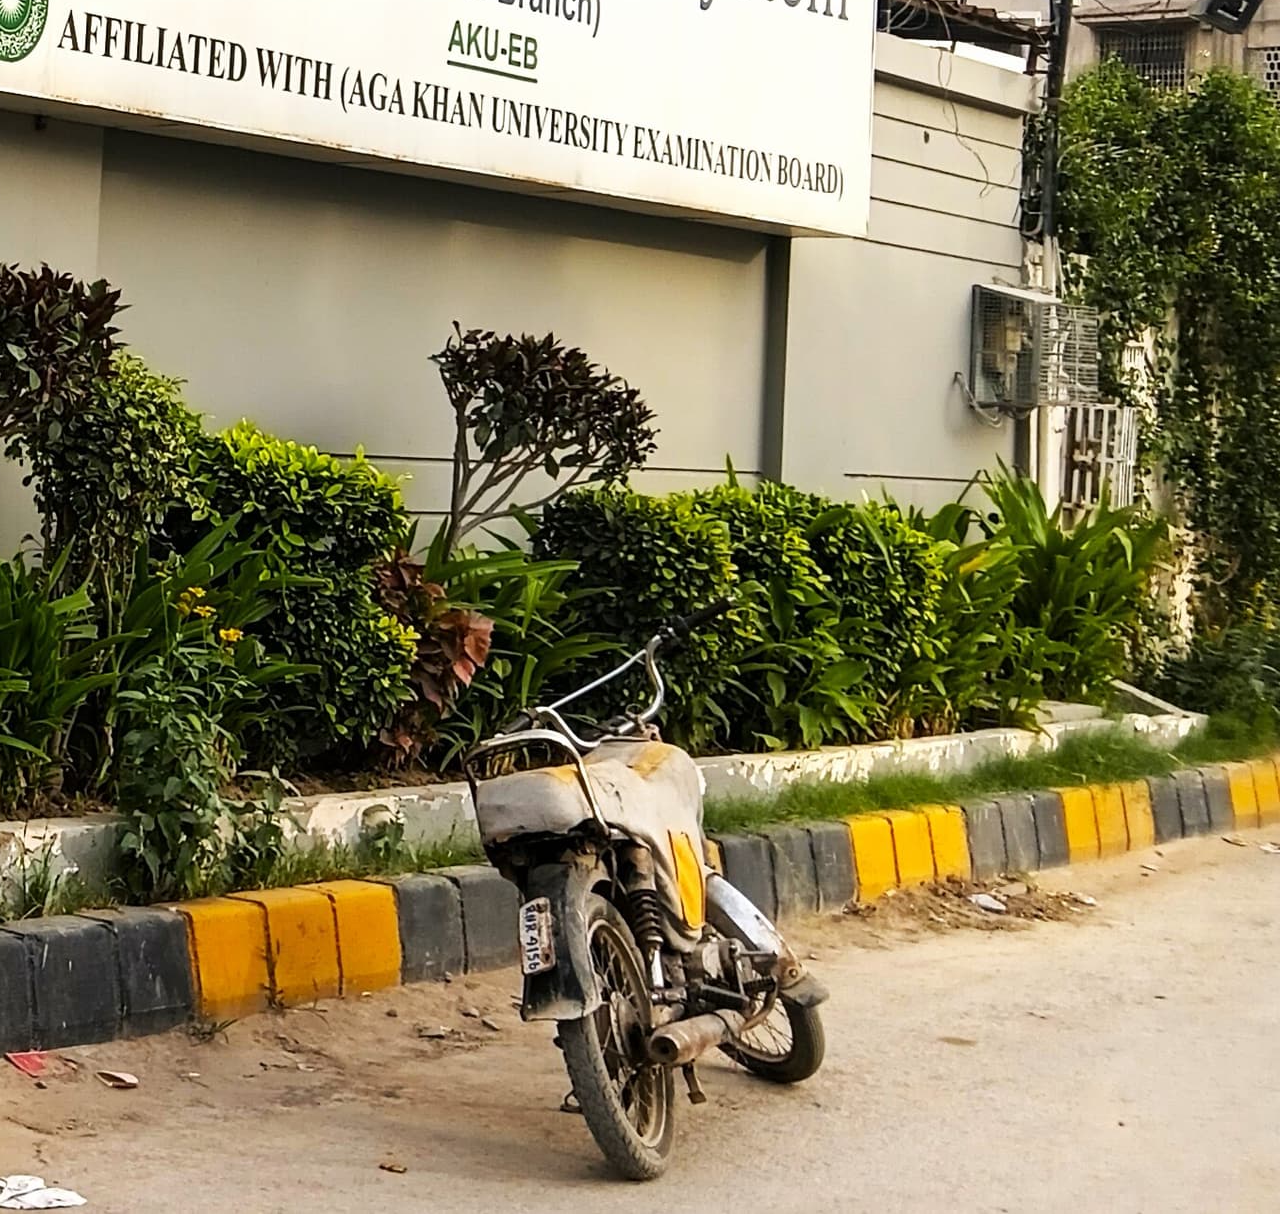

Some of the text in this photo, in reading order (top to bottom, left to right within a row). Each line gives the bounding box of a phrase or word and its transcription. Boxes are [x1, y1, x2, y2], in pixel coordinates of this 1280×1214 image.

[56, 9, 845, 202] AFFILIATED WITH (AGA KHAN UNIVERSITY EXAMINATION BOARD)
[447, 19, 539, 70] AKU-EB
